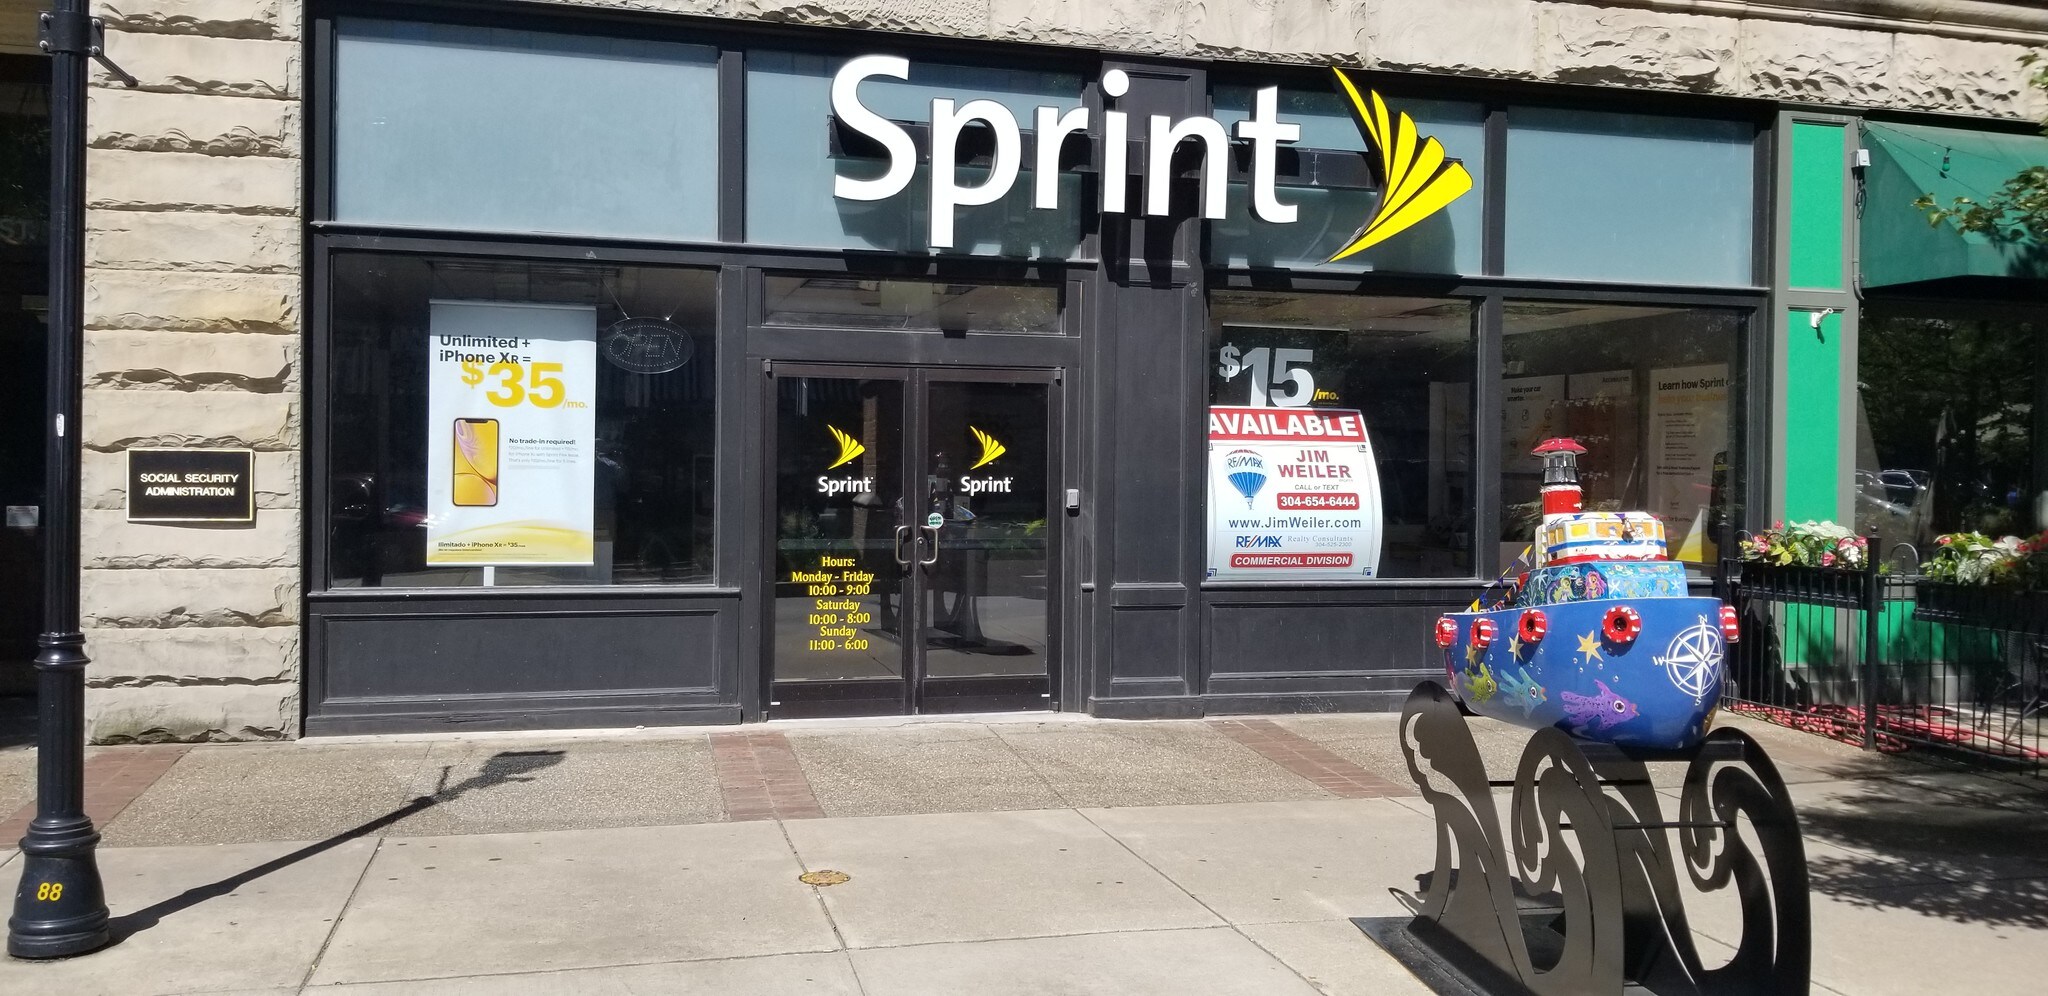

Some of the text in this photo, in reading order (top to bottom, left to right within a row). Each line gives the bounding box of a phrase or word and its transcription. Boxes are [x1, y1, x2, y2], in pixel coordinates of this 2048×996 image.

[831, 54, 1301, 248] Sprint
[440, 334, 531, 348] Unlimited +
[609, 333, 684, 358] OPEN
[439, 349, 495, 363] iPhone
[1523, 386, 1533, 394] your
[1533, 385, 1542, 393] car
[1658, 377, 1725, 391] Learn how Sprint
[1209, 413, 1360, 437] AVAILABLE
[1228, 455, 1264, 469] RE/MAX
[1296, 449, 1329, 463] JIM
[140, 473, 239, 483] SOCIAL SECURITY
[1277, 464, 1352, 478] WEILER
[145, 486, 235, 496] ADMINISTRATION
[818, 475, 874, 497] Sprint
[960, 476, 1013, 497] Sprint
[1281, 496, 1357, 507] 304-654-6444
[1228, 517, 1362, 529] www.JimWeiler.com
[1236, 534, 1283, 549] RE/MAX
[1287, 535, 1310, 543] Realty
[822, 556, 856, 567] Hours:
[1235, 556, 1350, 566] COMMERCIAL DIVISION
[791, 571, 833, 585] Monday
[843, 571, 874, 585] Friday
[809, 585, 837, 596] 10:00
[846, 584, 870, 596] 9:00
[816, 599, 860, 613] Saturday
[809, 613, 837, 625] 10:00
[847, 612, 871, 624] 8:00
[1698, 614, 1708, 624] N
[820, 625, 857, 639] Sunday
[809, 639, 835, 651] 11:00
[845, 639, 868, 650] 6:00
[1652, 656, 1664, 666] W
[37, 882, 63, 902] 88
